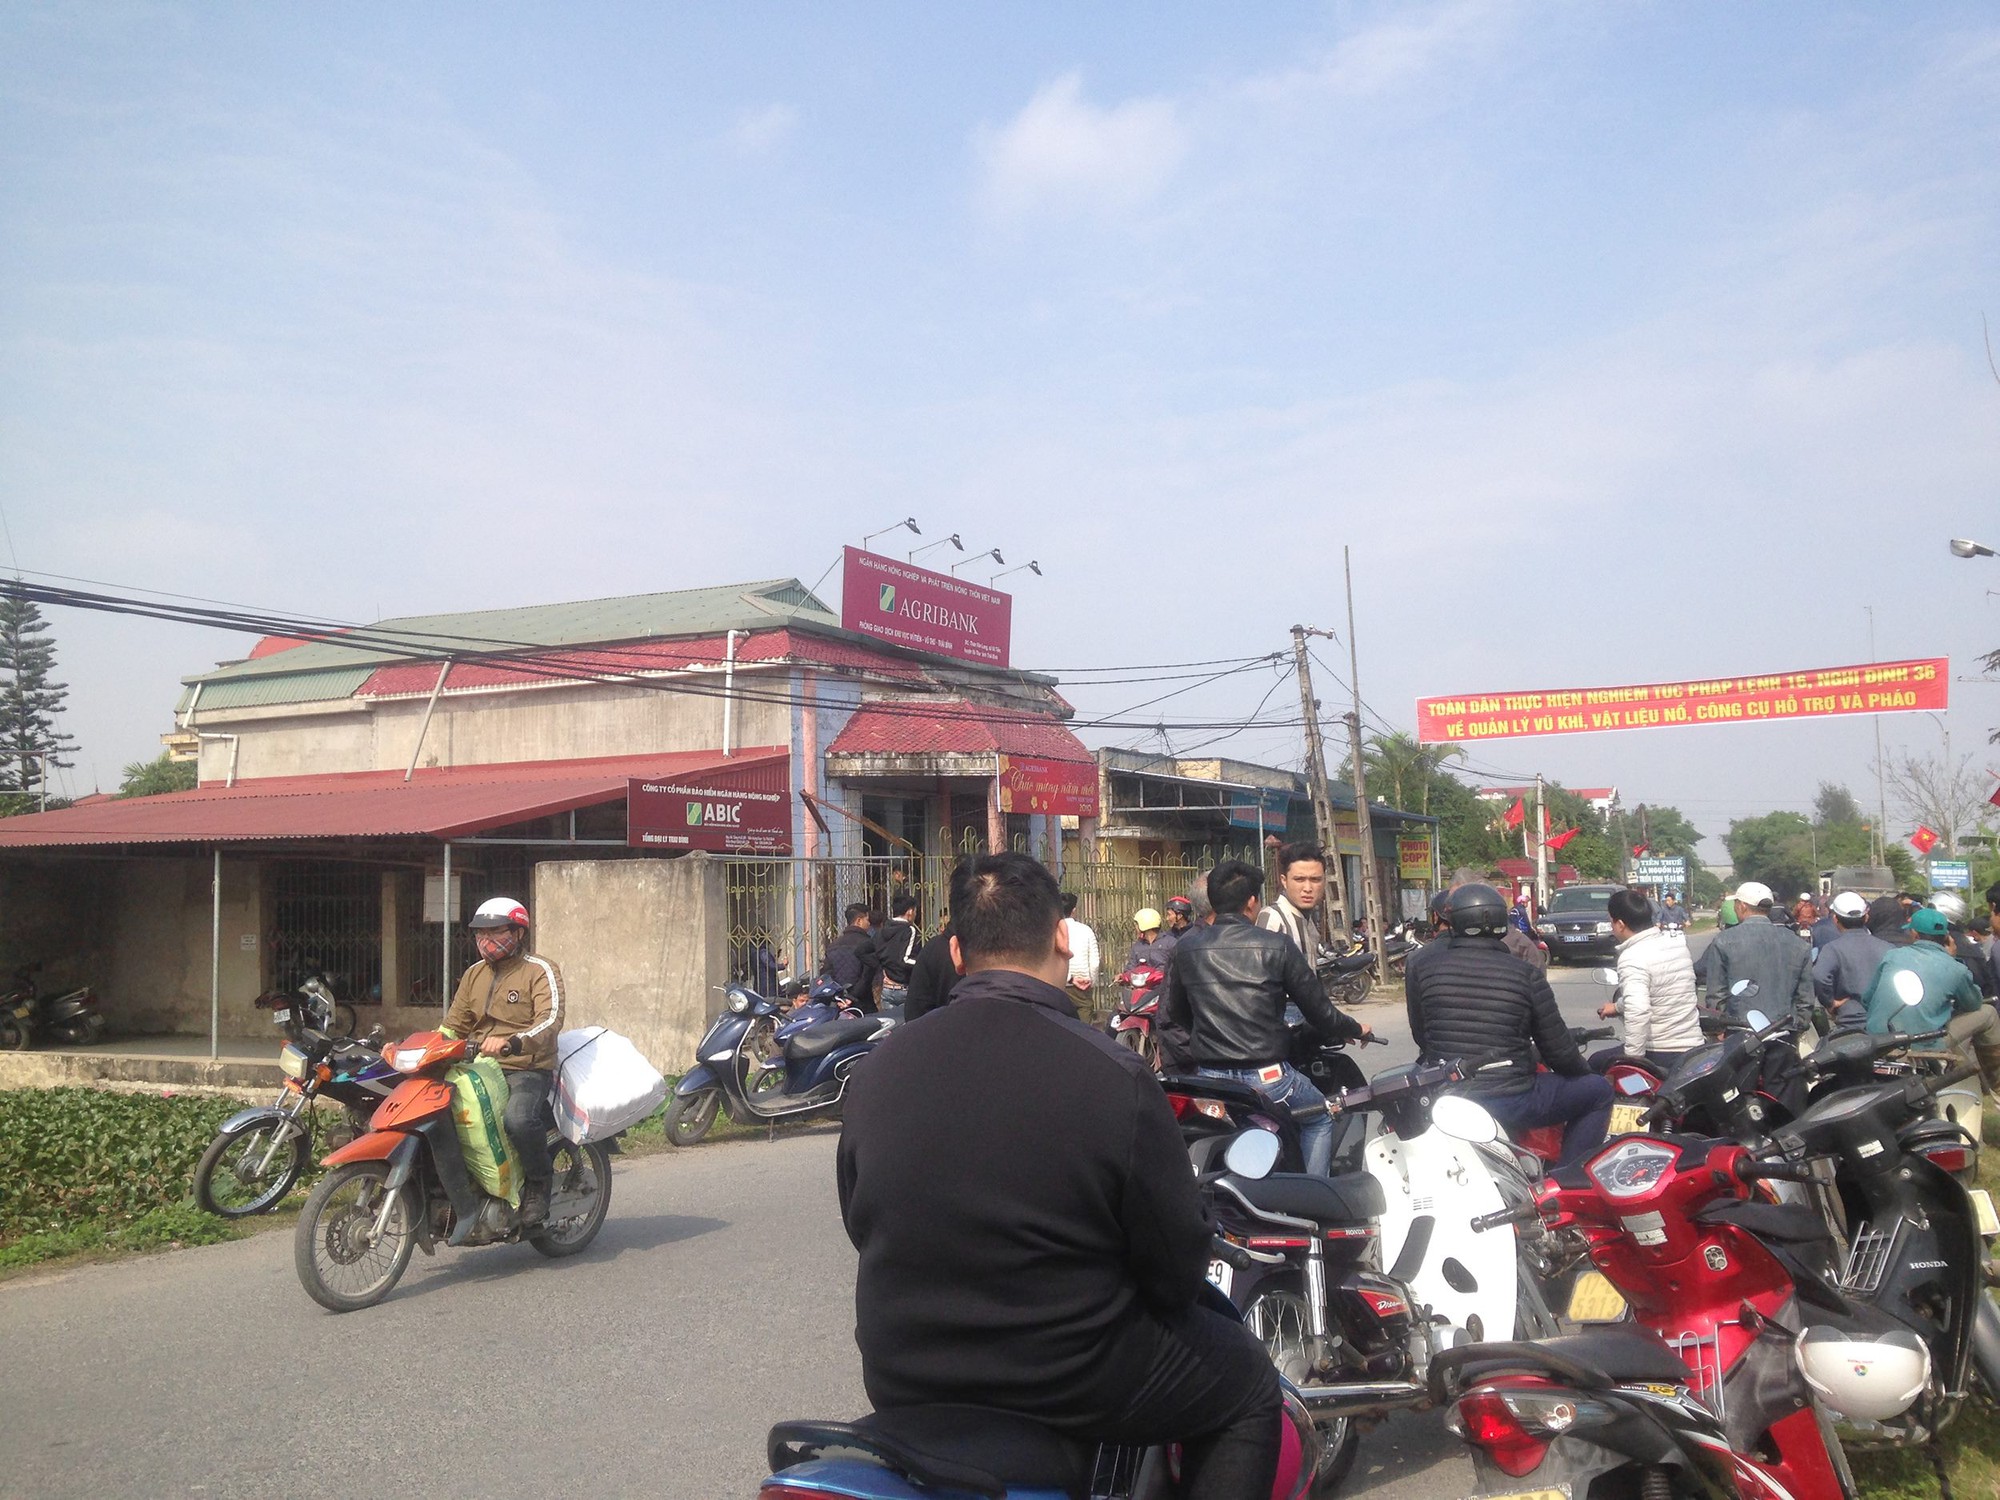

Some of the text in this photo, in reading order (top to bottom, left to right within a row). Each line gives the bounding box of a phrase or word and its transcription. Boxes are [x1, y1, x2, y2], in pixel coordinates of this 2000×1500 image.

[900, 598, 978, 634] AGRIBANK
[1470, 697, 1500, 714] DÂN
[1504, 694, 1542, 712] THỰC
[1546, 690, 1582, 710] HIỆN
[1817, 671, 1860, 687] NGHỊ
[1864, 668, 1908, 686] ĐỊNH
[1913, 665, 1936, 680] 36
[1468, 717, 1508, 736] QUẢN
[1512, 716, 1529, 733] LÝ
[1534, 714, 1554, 732] VŨ
[1558, 712, 1588, 730] KHÍ,
[1592, 710, 1620, 730] VẬT
[1625, 706, 1659, 726] LIỆU
[1696, 702, 1742, 720] CÔNG
[1747, 701, 1770, 718] CỤ
[1774, 694, 1798, 714] HỖ
[1802, 695, 1836, 714] TRỢ
[1840, 692, 1864, 710] VÀ
[1868, 688, 1917, 708] PHÁO
[1008, 766, 1034, 792] Chúc
[1060, 783, 1078, 795] năm
[1401, 841, 1429, 850] PHOTO
[1402, 852, 1428, 862] COPY
[1910, 1260, 1948, 1270] HONDA
